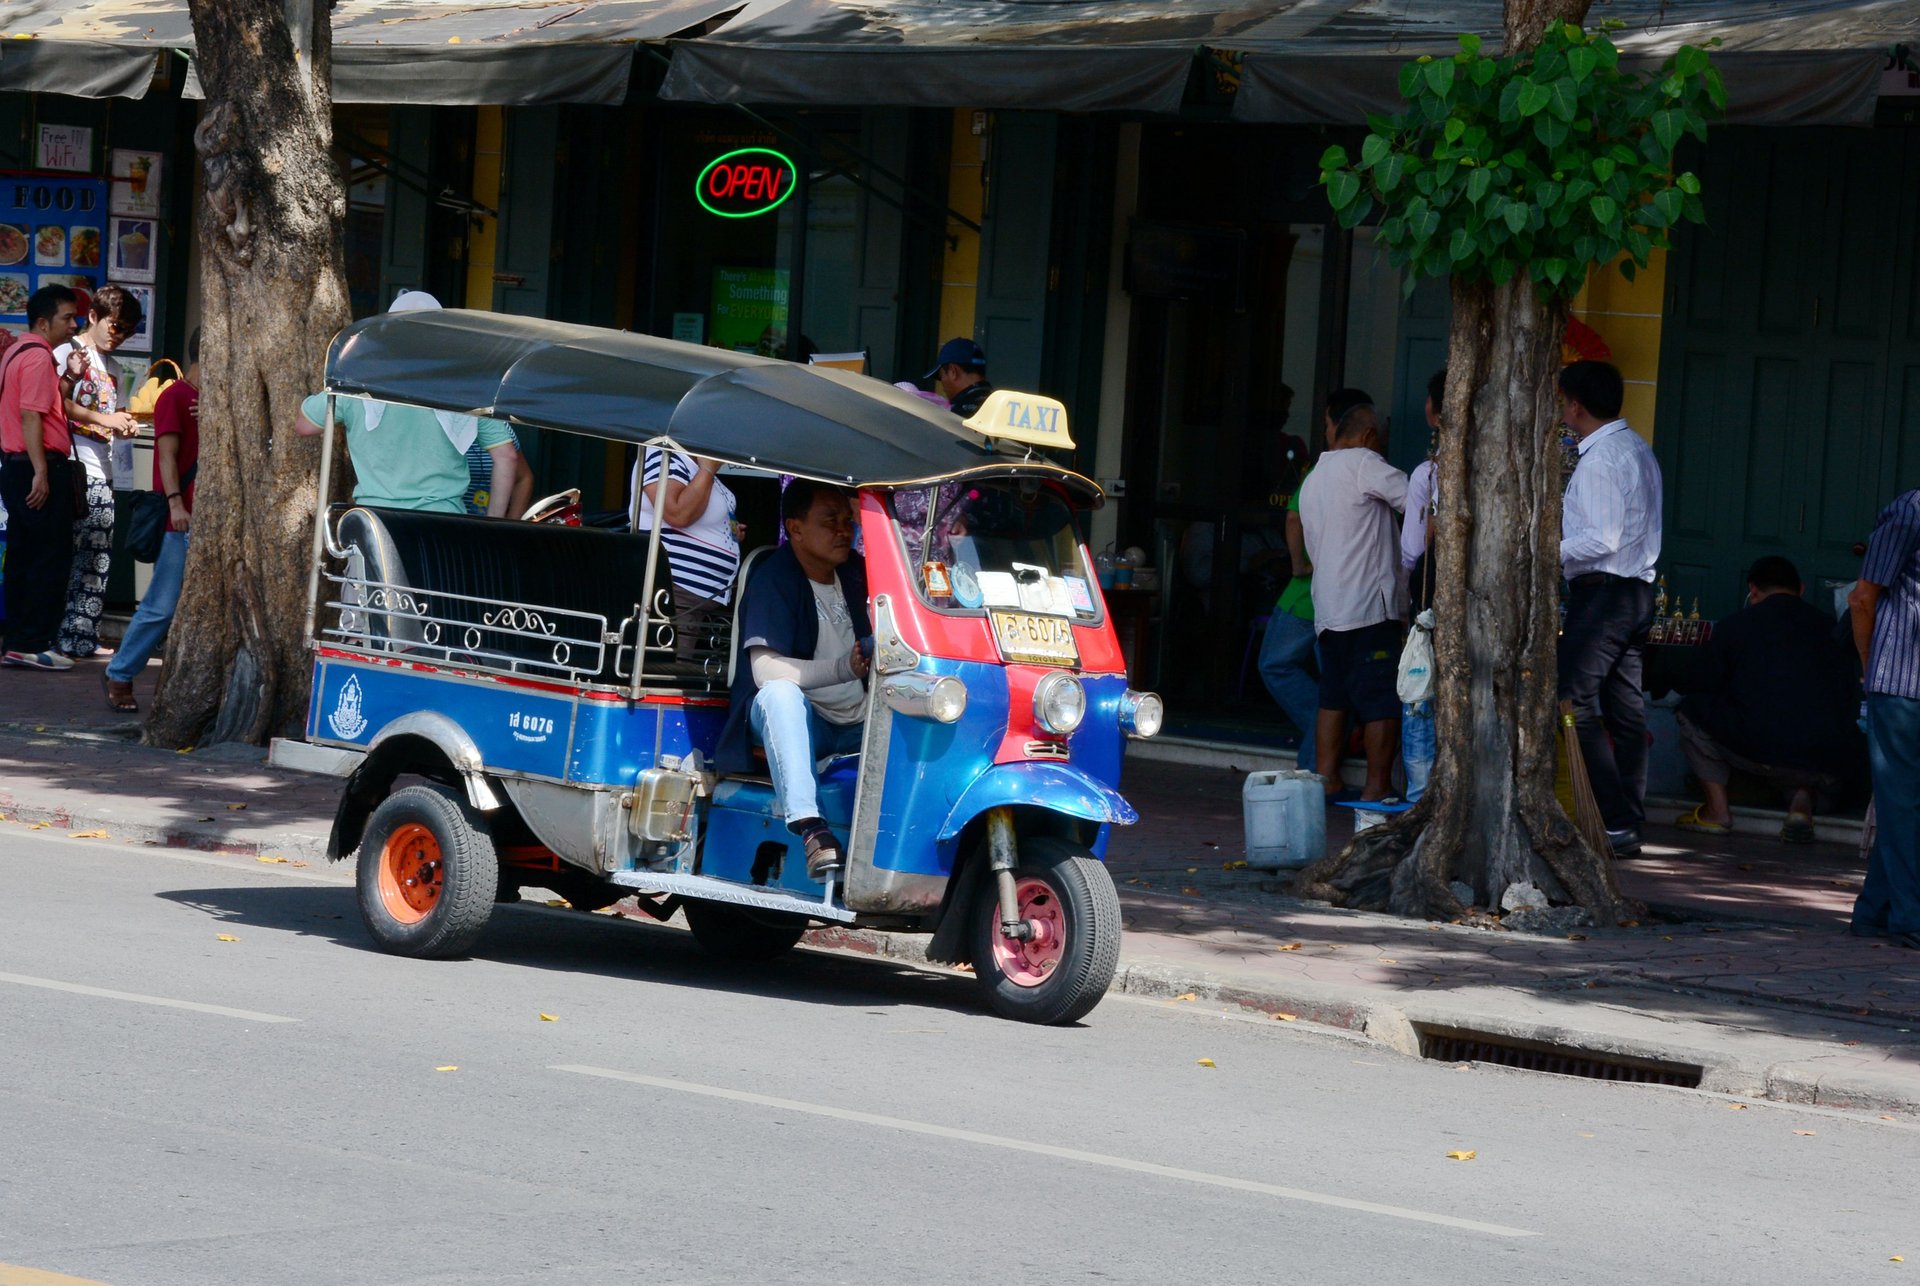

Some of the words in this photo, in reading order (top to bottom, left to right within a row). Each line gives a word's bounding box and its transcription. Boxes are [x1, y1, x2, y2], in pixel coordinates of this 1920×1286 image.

[41, 127, 67, 144] Free
[708, 163, 784, 201] OPEN
[11, 185, 97, 213] FOOD
[720, 270, 747, 282] There's
[729, 284, 788, 304] Something
[1007, 400, 1060, 433] TAXI
[1028, 655, 1058, 663] TOYOTA
[523, 715, 554, 734] 6076
